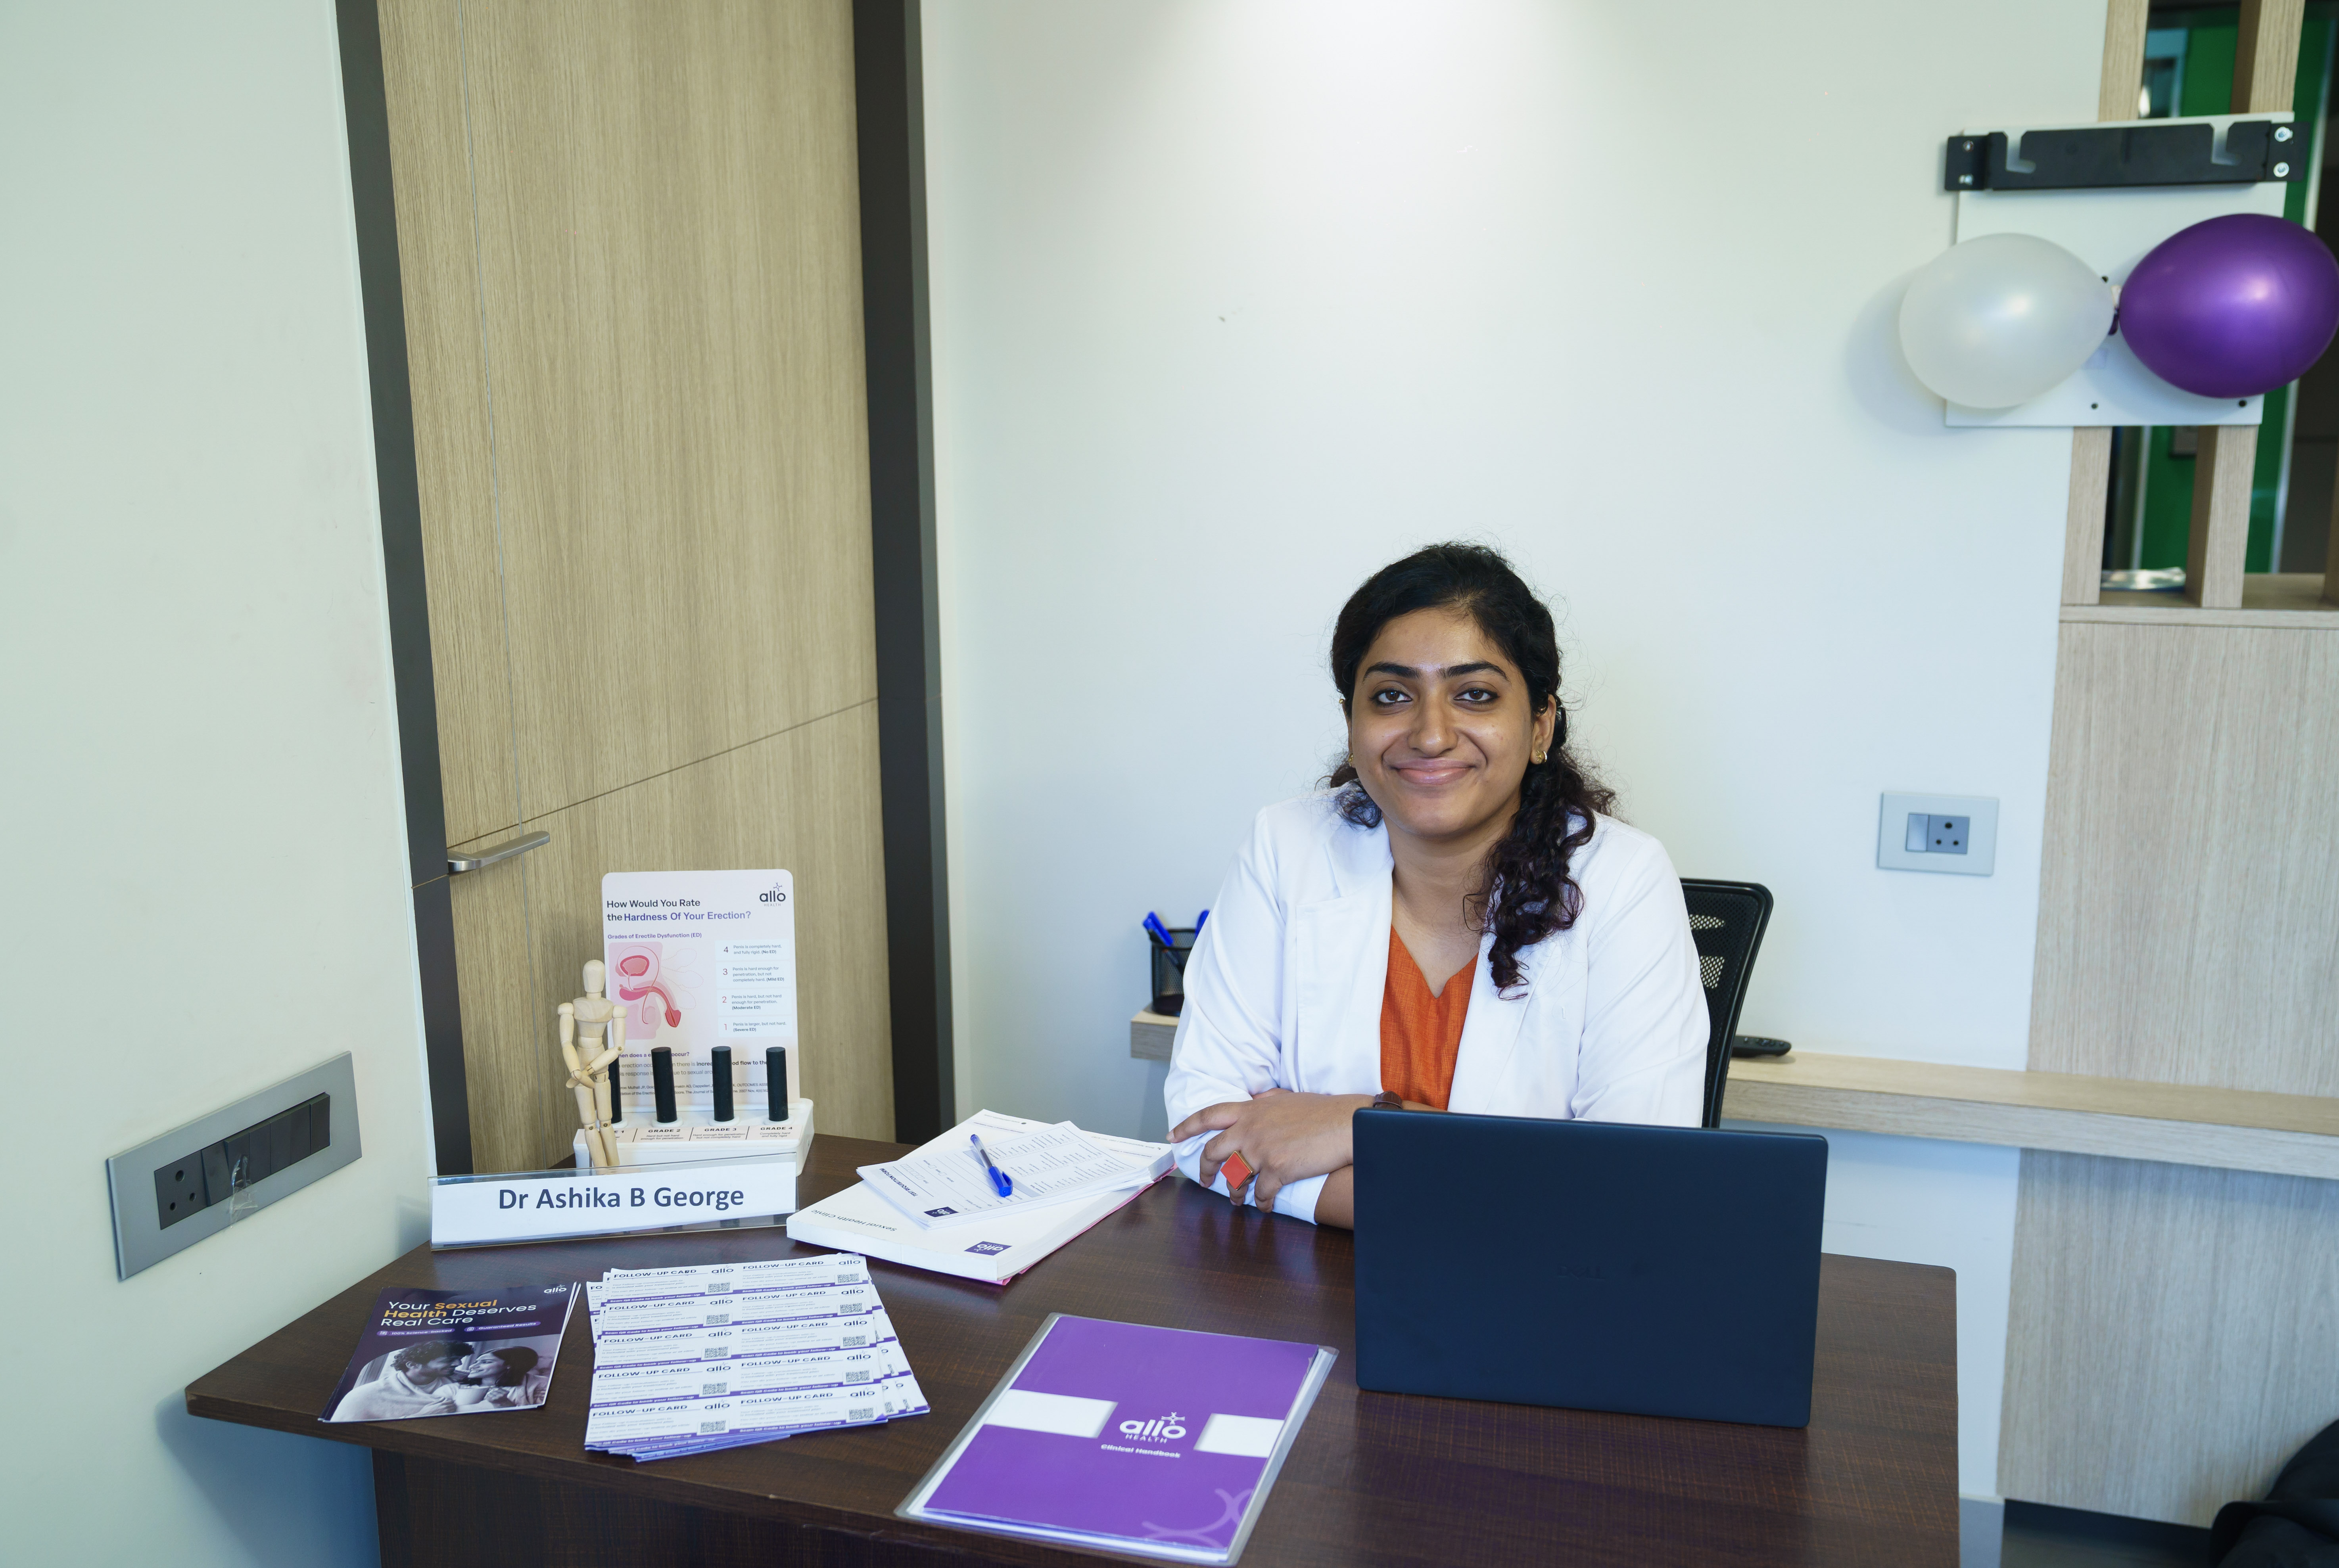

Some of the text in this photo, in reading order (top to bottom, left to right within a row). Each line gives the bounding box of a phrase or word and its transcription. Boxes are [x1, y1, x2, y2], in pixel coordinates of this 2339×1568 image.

[759, 891, 786, 902] allo
[708, 911, 751, 920] Erection?
[879, 1168, 891, 1177] FORM
[889, 1175, 911, 1191] REQUISITION
[499, 1187, 744, 1211] Dr Ashika B George
[811, 1210, 897, 1231] Sexual Health Clinic
[389, 1300, 497, 1310] Your Sexual
[452, 1305, 537, 1317] Deserves
[742, 1358, 800, 1367] FOLLOW-UP
[599, 1370, 660, 1378] FOLLOW-UP
[741, 1395, 802, 1404] FOLLOW-UP
[1119, 1419, 1186, 1439] allo
[1125, 1434, 1167, 1443] HEALTH
[1101, 1444, 1181, 1458] Clinical Handbook
